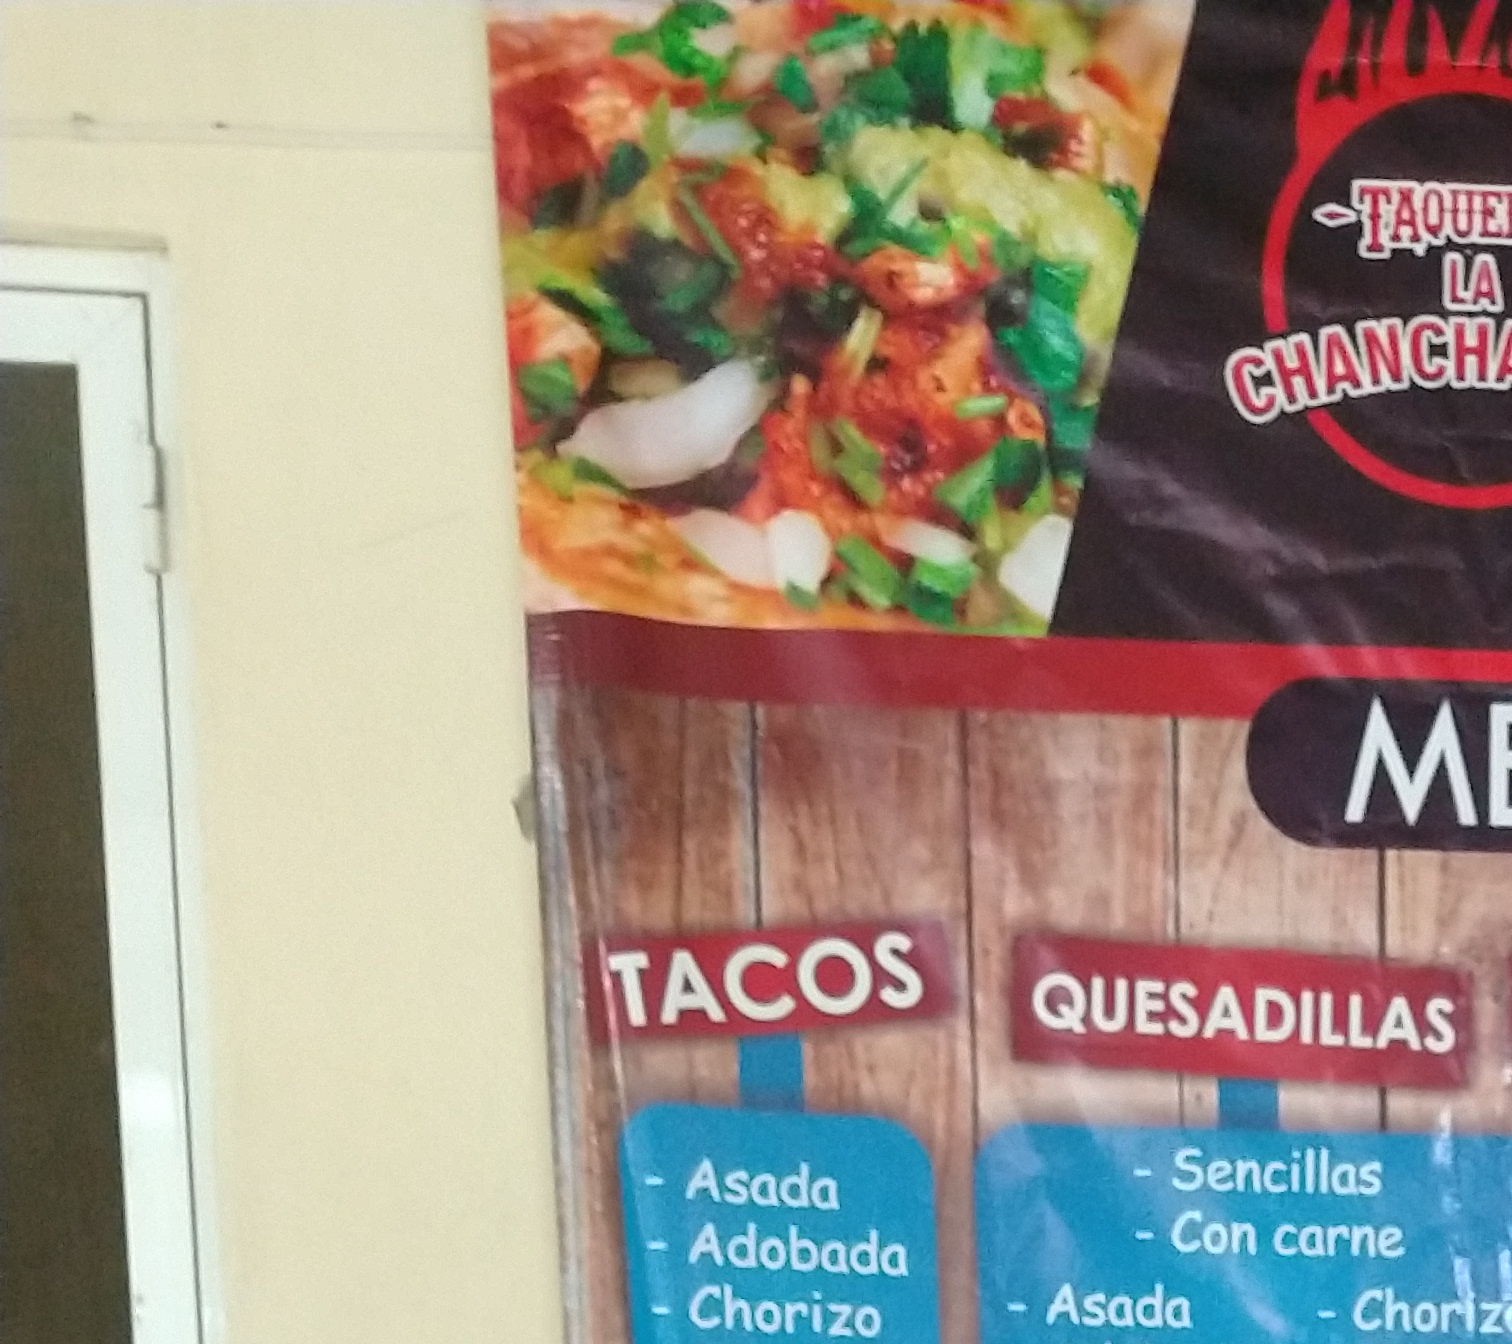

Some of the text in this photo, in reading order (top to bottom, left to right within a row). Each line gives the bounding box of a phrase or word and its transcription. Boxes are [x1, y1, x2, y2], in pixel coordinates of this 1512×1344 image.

[1443, 251, 1503, 312] LA
[608, 930, 924, 1027] TACOS
[1031, 972, 1456, 1055] QUESADILLAS
[685, 1157, 840, 1210] Asada
[1171, 1146, 1383, 1195] Sencillas
[688, 1223, 910, 1277] Adobada
[1171, 1211, 1406, 1258] Con carne
[688, 1285, 881, 1337] Chorizo
[1045, 1282, 1193, 1329] Asada
